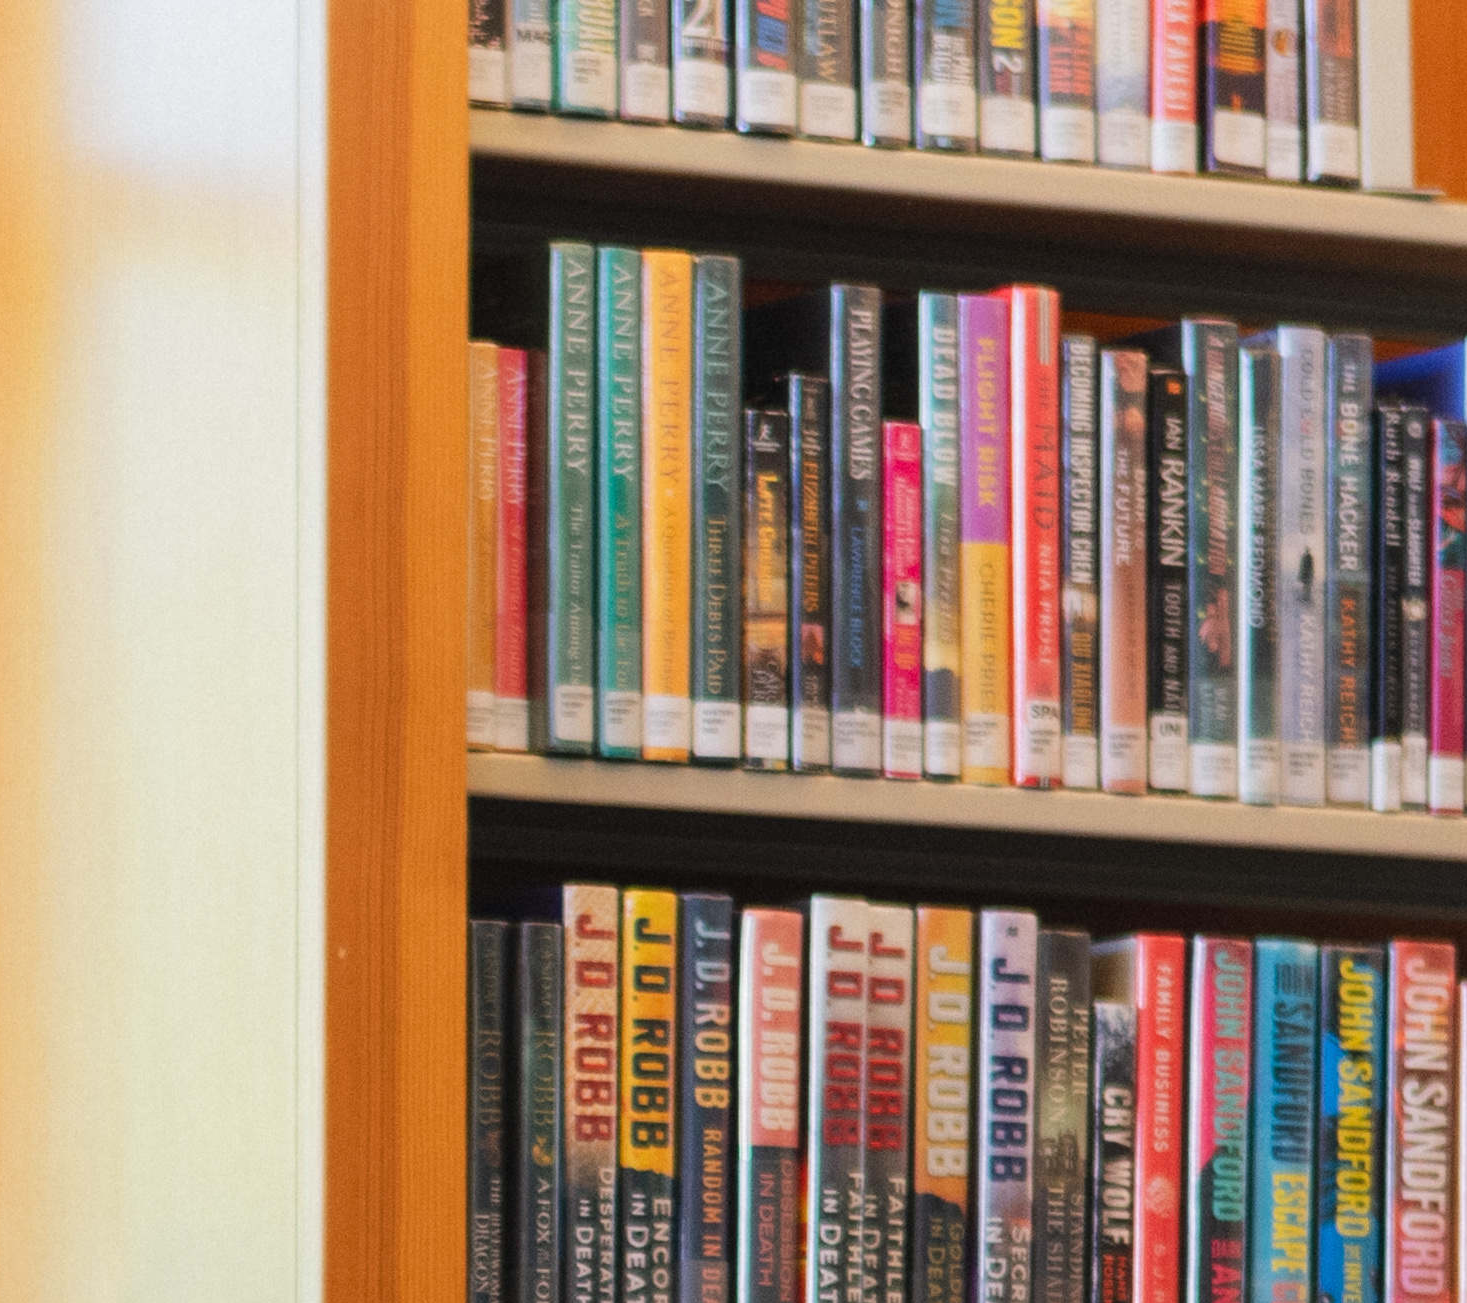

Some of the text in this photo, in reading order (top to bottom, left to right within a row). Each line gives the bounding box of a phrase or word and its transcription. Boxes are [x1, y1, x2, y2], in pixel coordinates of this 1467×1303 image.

[993, 53, 1024, 73] 2
[565, 258, 588, 475] ANNE PERRY
[612, 264, 633, 482] ANNE PERRY
[658, 268, 680, 484] ANNE PERRY
[706, 281, 729, 494] ANNE PERRY
[849, 308, 871, 480] PLAYING GAMES
[933, 327, 956, 487] DEAD BLOW
[976, 337, 997, 506] FLIGHT RISK
[1033, 424, 1054, 530] MAID
[1070, 343, 1094, 583] BECOMING INSPECTOR CHEN
[1165, 418, 1180, 449] IAN
[1339, 402, 1359, 467] BONE
[1160, 457, 1184, 566] RANKIN
[1339, 476, 1359, 571] HACKER
[706, 514, 727, 694] THREE DEBTS PAID
[573, 1014, 616, 1143] ROBB
[631, 1019, 672, 1151] ROBB
[694, 1003, 730, 1109] ROBB
[759, 1031, 799, 1131] ROBB
[823, 1021, 862, 1145] ROBB
[927, 1048, 969, 1177] ROBB
[990, 1055, 1029, 1183] ROBB
[1154, 964, 1172, 1151] FAMILY BUSINESS
[1212, 952, 1244, 1222] JOHN SANDFORD
[1335, 960, 1373, 1236] JOHN SANDFORD
[1103, 1087, 1132, 1244] CRY WOLF
[1401, 958, 1449, 1294] JOHN SANDFORD
[579, 1200, 590, 1217] IN
[632, 1194, 644, 1215] IN
[702, 1129, 722, 1257] RANDOM IN
[824, 1190, 839, 1213] IN
[986, 1216, 1003, 1243] IN
[1272, 1173, 1308, 1273] ESCAPE
